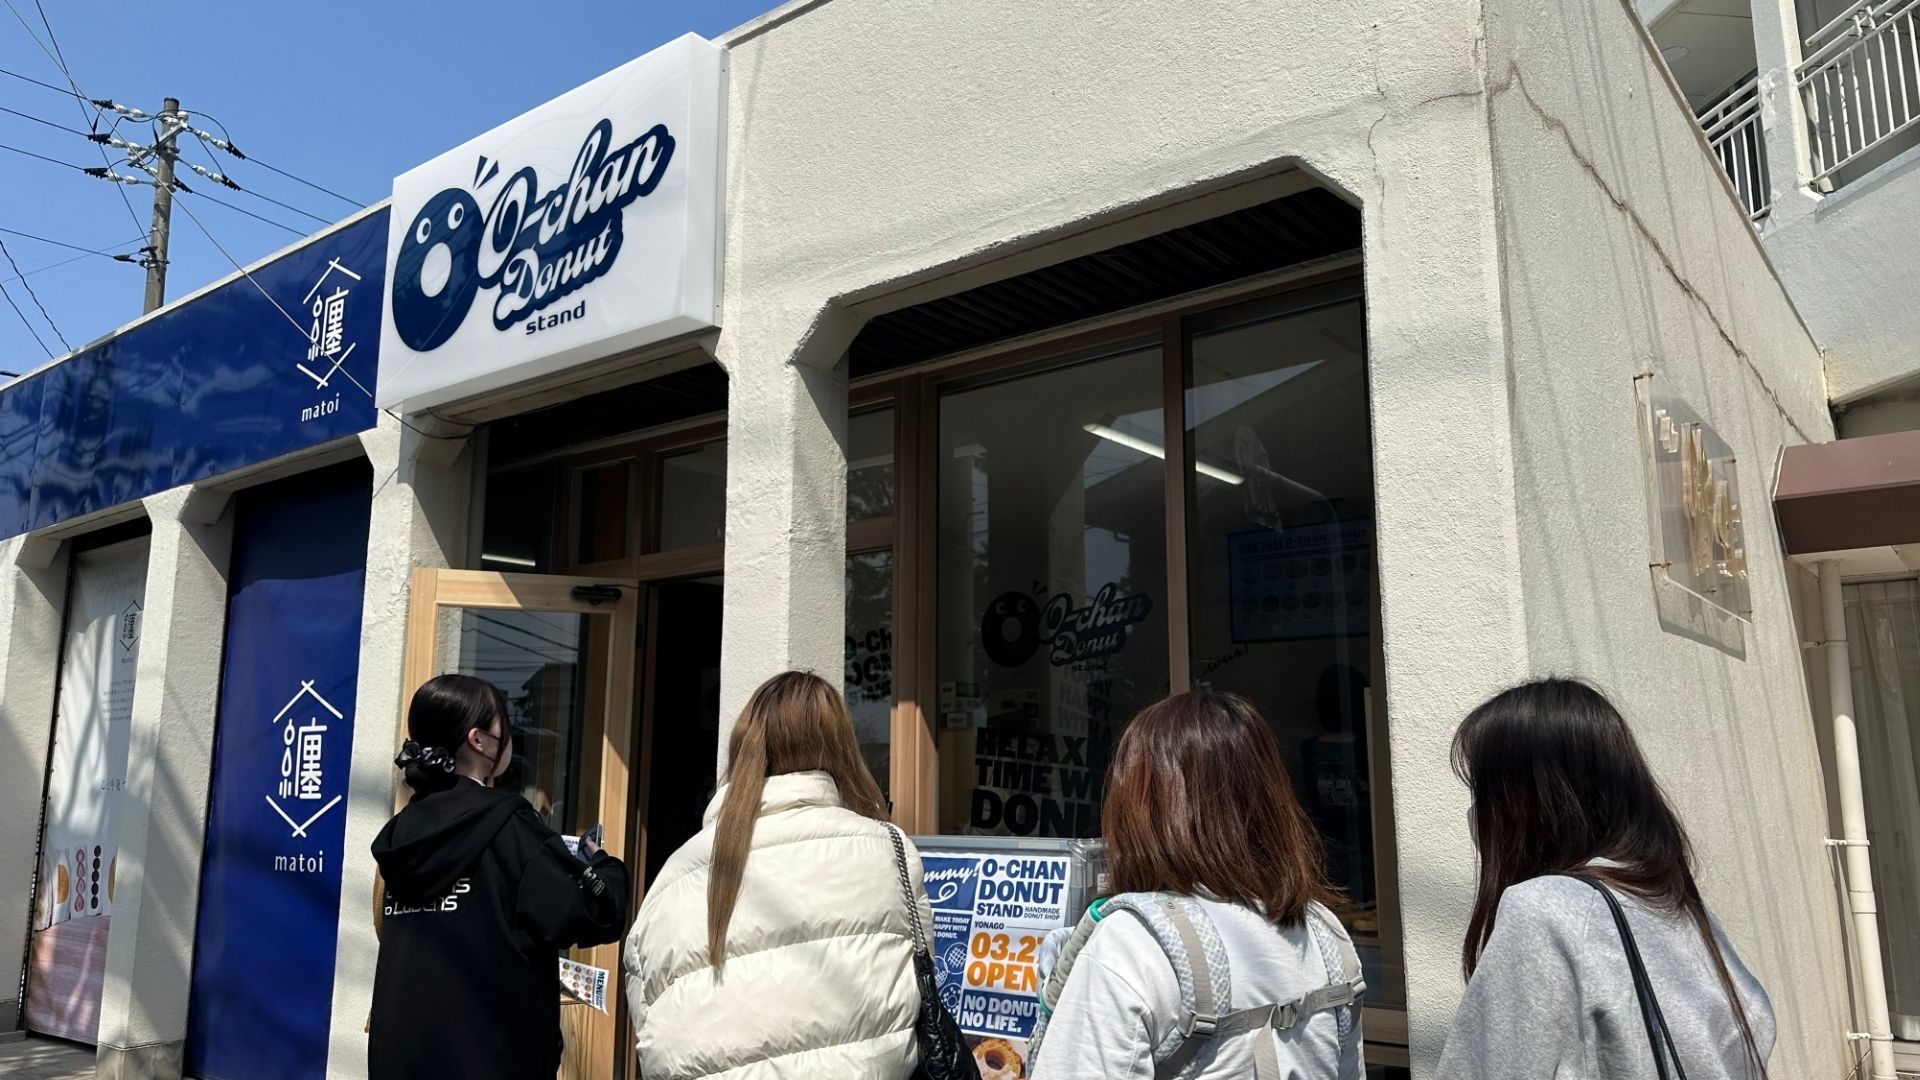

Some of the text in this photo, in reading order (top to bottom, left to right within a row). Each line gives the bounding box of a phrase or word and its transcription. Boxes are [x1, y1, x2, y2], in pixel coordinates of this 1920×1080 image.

[477, 119, 672, 285] O-chan
[495, 216, 618, 326] Donut
[525, 300, 586, 335] stand
[301, 392, 339, 422] matoi
[1038, 582, 1152, 644] O-chan
[1051, 626, 1125, 666] Donut
[976, 727, 1087, 767] RELAX
[974, 757, 1052, 796] TIME
[275, 850, 323, 872] matoi
[982, 858, 1067, 880] O-CHAN
[978, 880, 1064, 905] DONUT
[934, 915, 971, 925] MAKE TODAY
[976, 903, 1024, 918] STAND
[1024, 906, 1061, 915] HANDMADE
[1024, 912, 1044, 920] DONUT
[974, 921, 1004, 930] YONAGO
[971, 931, 1044, 963] 03.2
[966, 960, 1038, 993] OPEN
[963, 995, 1040, 1018] NO DONUT
[961, 1012, 1022, 1033] NO LIFE.
